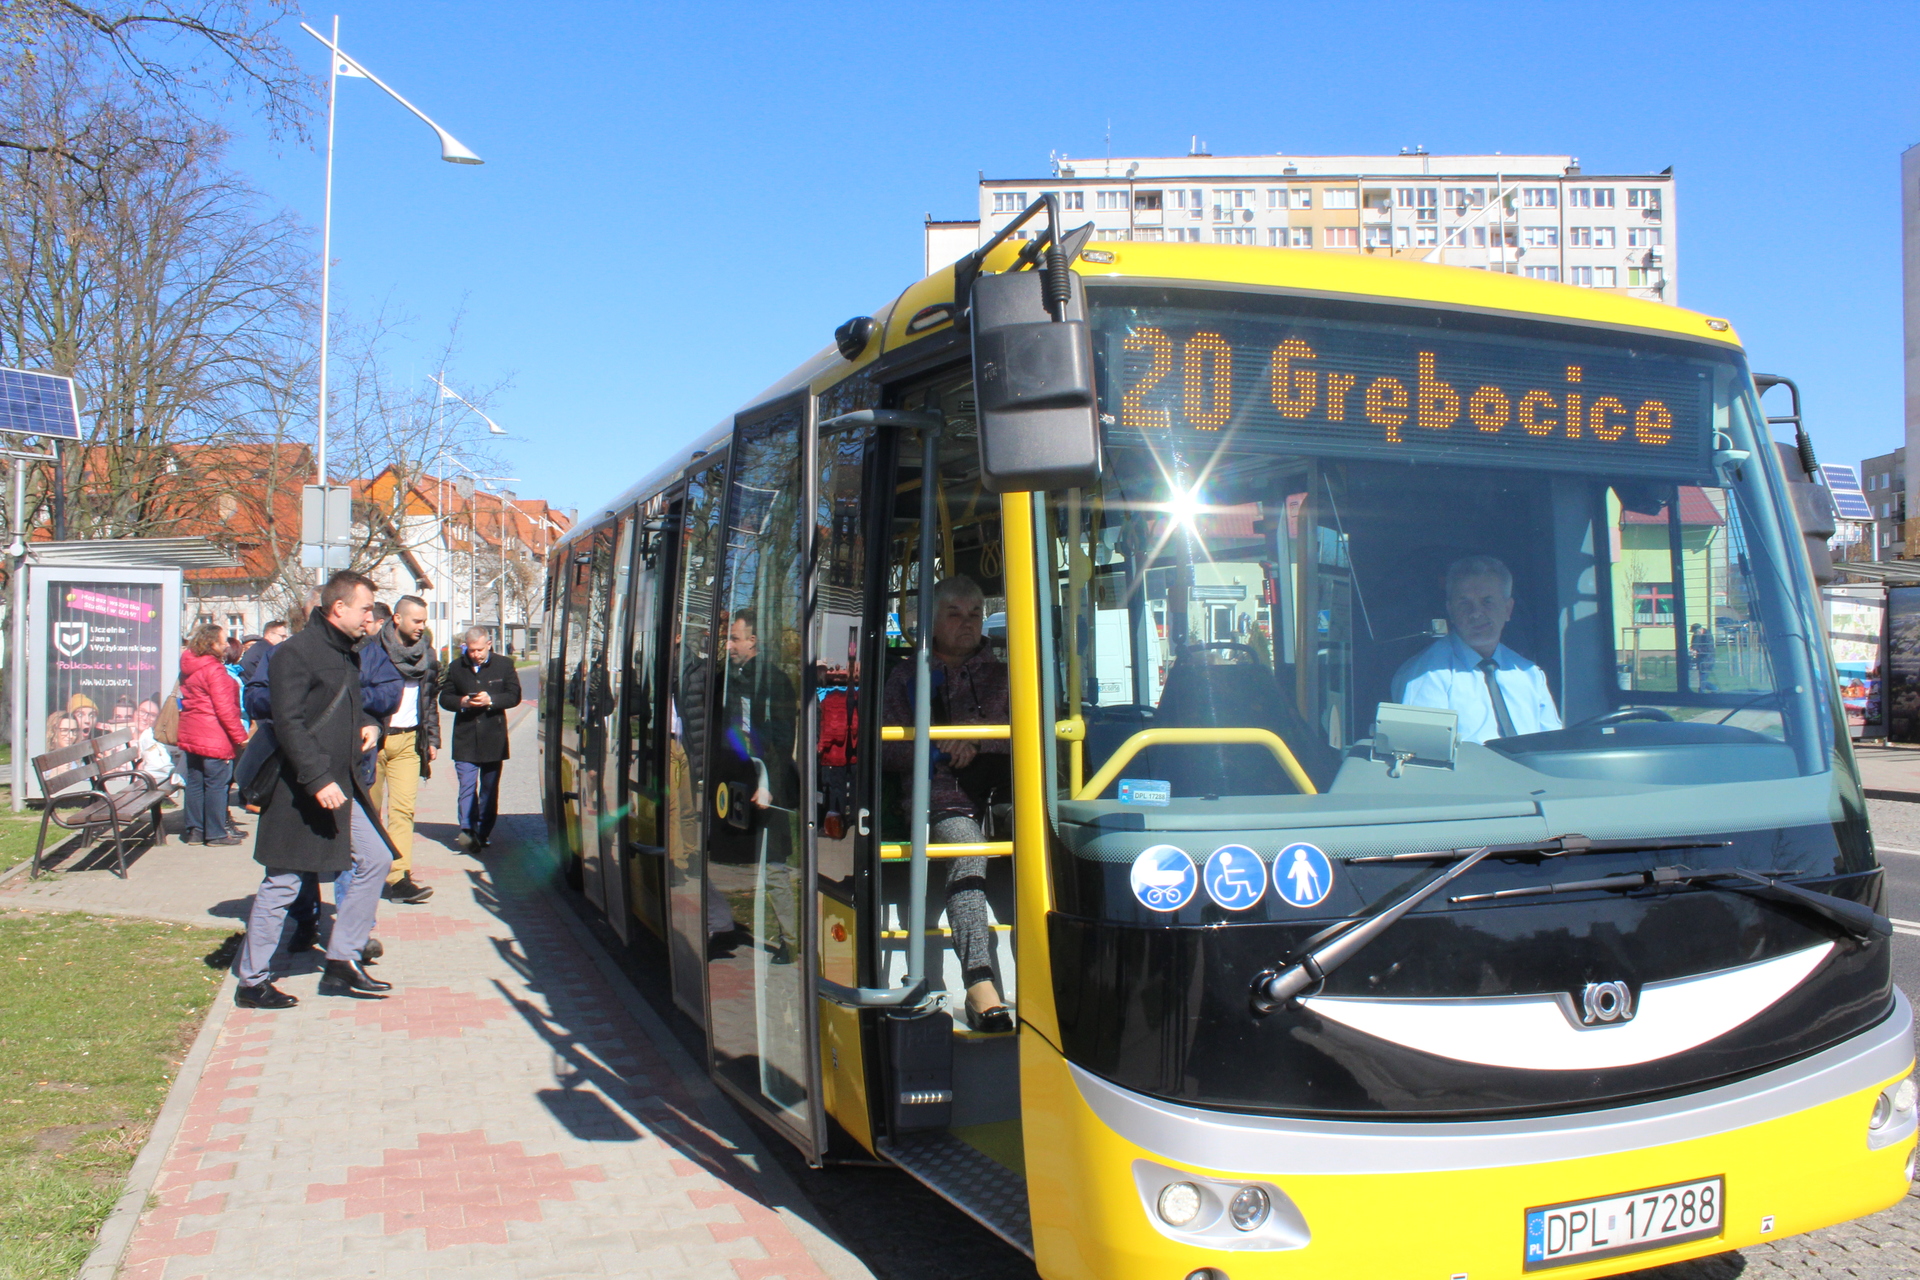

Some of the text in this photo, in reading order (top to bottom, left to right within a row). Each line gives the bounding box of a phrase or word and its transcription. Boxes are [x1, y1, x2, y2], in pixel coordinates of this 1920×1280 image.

[1122, 327, 1673, 445] 20 Grębocice
[109, 600, 140, 611] wszystko
[90, 626, 126, 634] Uczelnia
[1547, 1185, 1715, 1256] DPL 17288
[1529, 1242, 1544, 1256] PL
